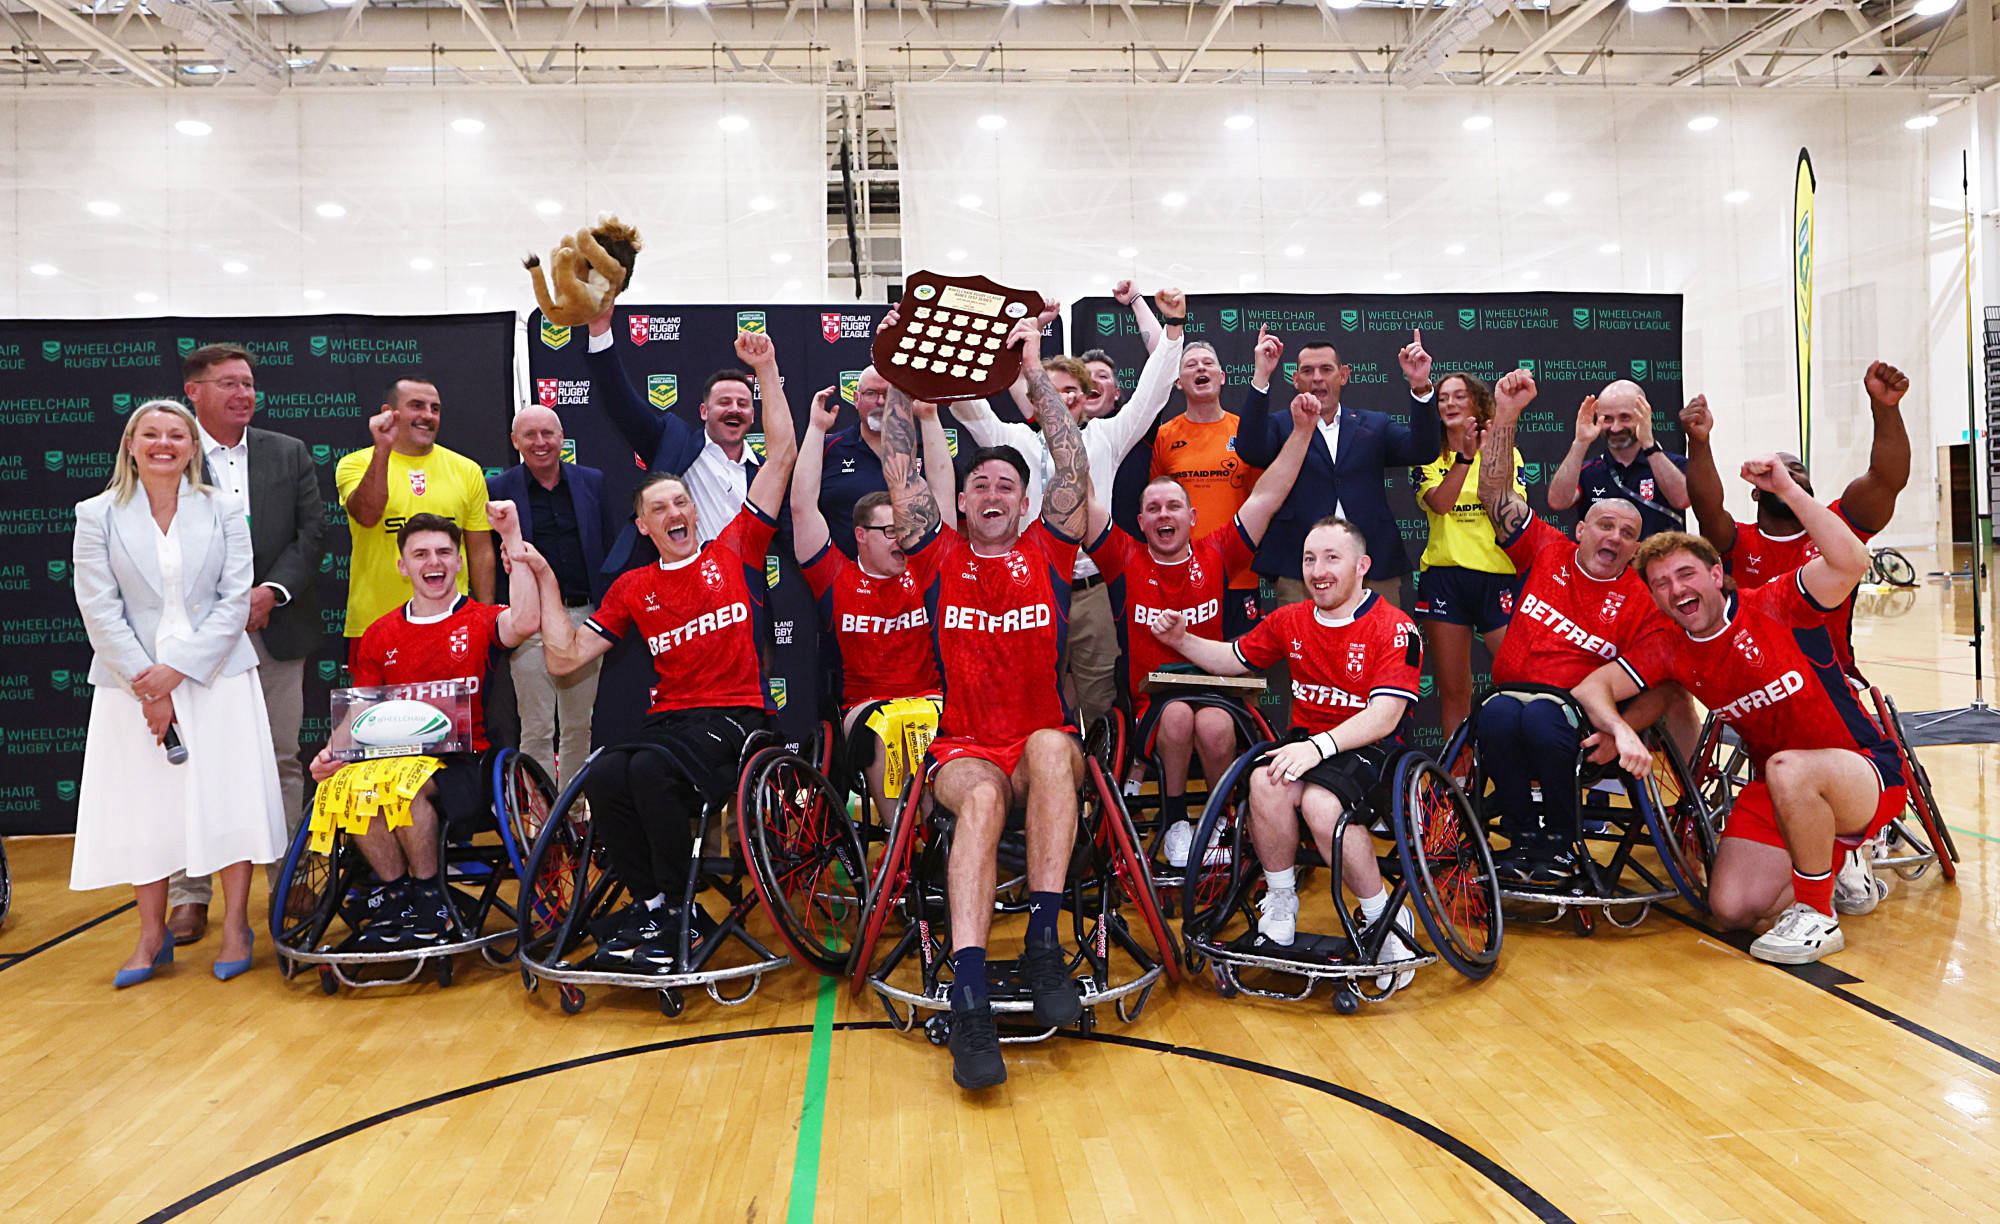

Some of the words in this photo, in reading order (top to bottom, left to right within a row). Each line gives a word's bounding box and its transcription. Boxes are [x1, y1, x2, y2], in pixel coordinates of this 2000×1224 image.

[1248, 310, 1315, 320] WHEELCHAIR
[1368, 310, 1434, 320] WHEELCHAIR
[1485, 308, 1549, 318] WHEELCHAIR
[1599, 309, 1662, 319] WHEELCHAIR
[649, 324, 680, 333] RUGBY
[840, 322, 871, 331] RUGBY
[1184, 323, 1206, 333] GUE
[1286, 322, 1326, 332] LEAGUE
[1368, 322, 1402, 331] RUGBY
[1405, 321, 1444, 331] LEAGUE
[1486, 320, 1518, 329] RUGBY
[1521, 319, 1559, 328] LEAGUE
[1599, 320, 1632, 330] RUGBY
[1634, 321, 1671, 330] LEAGUE
[648, 332, 680, 340] LEAGUE
[840, 330, 870, 338] LEAGUE
[64, 341, 157, 355] WHEELCHAIR
[330, 339, 418, 350] WHEELCHAIR
[0, 358, 25, 370] GUE
[64, 357, 108, 369] RUGBY
[112, 355, 161, 367] LEAGUE
[330, 353, 371, 364] RUGBY
[375, 353, 423, 364] LEAGUE
[1431, 361, 1494, 371] WHEELCHAIR
[1544, 361, 1607, 370] WHEELCHAIR
[1545, 371, 1577, 381] RUGBY
[1580, 371, 1617, 381] LEAGUE
[558, 388, 590, 397] RUGBY
[0, 398, 90, 411] WHEELCHAIR
[267, 393, 357, 406] WHEELCHAIR
[557, 396, 589, 405] LEAGUE
[45, 411, 95, 423] LEAGUE
[267, 407, 310, 418] RUGBY
[313, 406, 362, 418] LEAGUE
[1518, 411, 1554, 421] LCHAIR
[1525, 423, 1564, 432] LEAGUE
[66, 452, 117, 465] WHEEL
[1, 469, 28, 480] GUE
[66, 467, 111, 478] RUGBY
[0, 508, 76, 521] WHEELCHA
[0, 522, 43, 534] RUGBY
[1134, 598, 1219, 627] BERED
[2, 617, 83, 631] WHEELCHA
[944, 603, 1050, 634] BETFRED
[648, 602, 748, 657] BETFRED
[1519, 592, 1618, 661] BETFRED
[775, 628, 793, 637] GBY
[2, 632, 48, 645] RUGBY
[776, 636, 793, 645] GUE
[0, 688, 36, 700] AGUE
[1291, 680, 1368, 709] BETFRE
[1711, 670, 1804, 722] ETFRED
[1259, 696, 1281, 705] GUE
[7, 728, 87, 741] WHEELCHA
[8, 743, 52, 755] RUGBY
